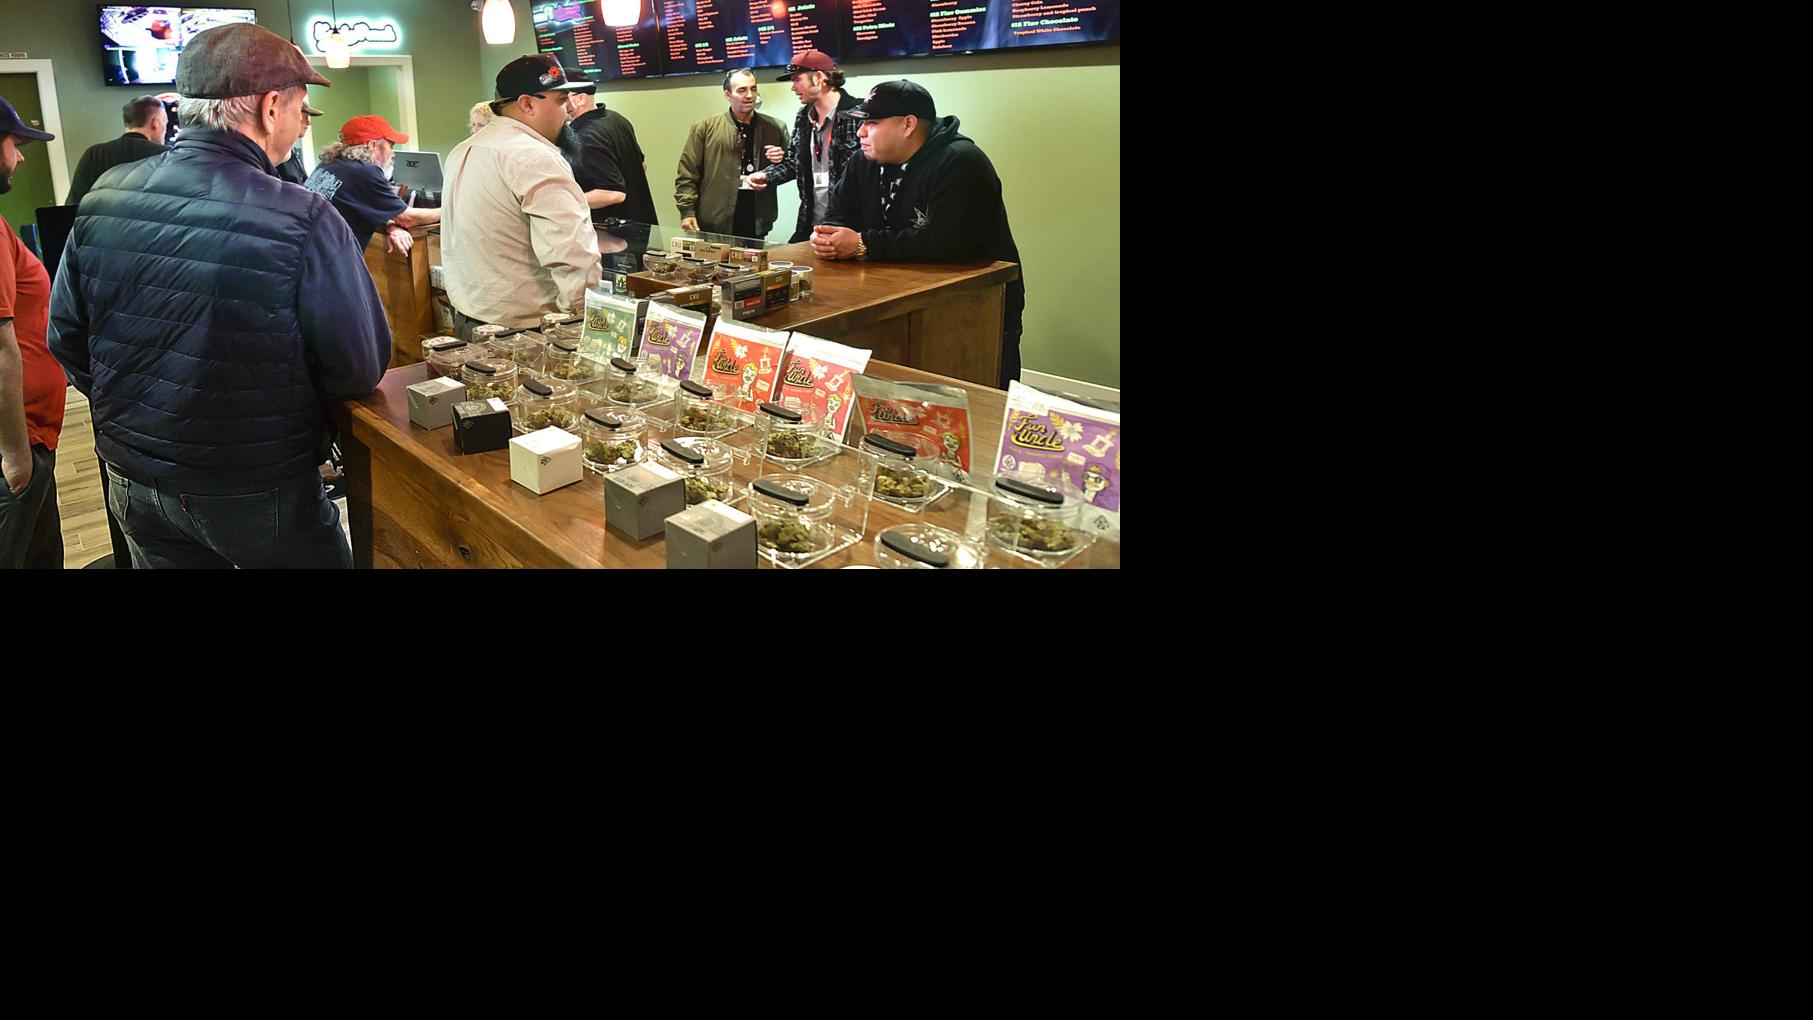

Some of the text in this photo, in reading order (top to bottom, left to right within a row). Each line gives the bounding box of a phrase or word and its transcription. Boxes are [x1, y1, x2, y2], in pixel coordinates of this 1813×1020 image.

[1040, 17, 1079, 26] Chocolate
[713, 362, 740, 374] Uncle
[787, 361, 805, 375] Fun
[784, 372, 815, 388] Uncle
[1014, 414, 1047, 433] Fun
[1012, 430, 1065, 452] Uncle
